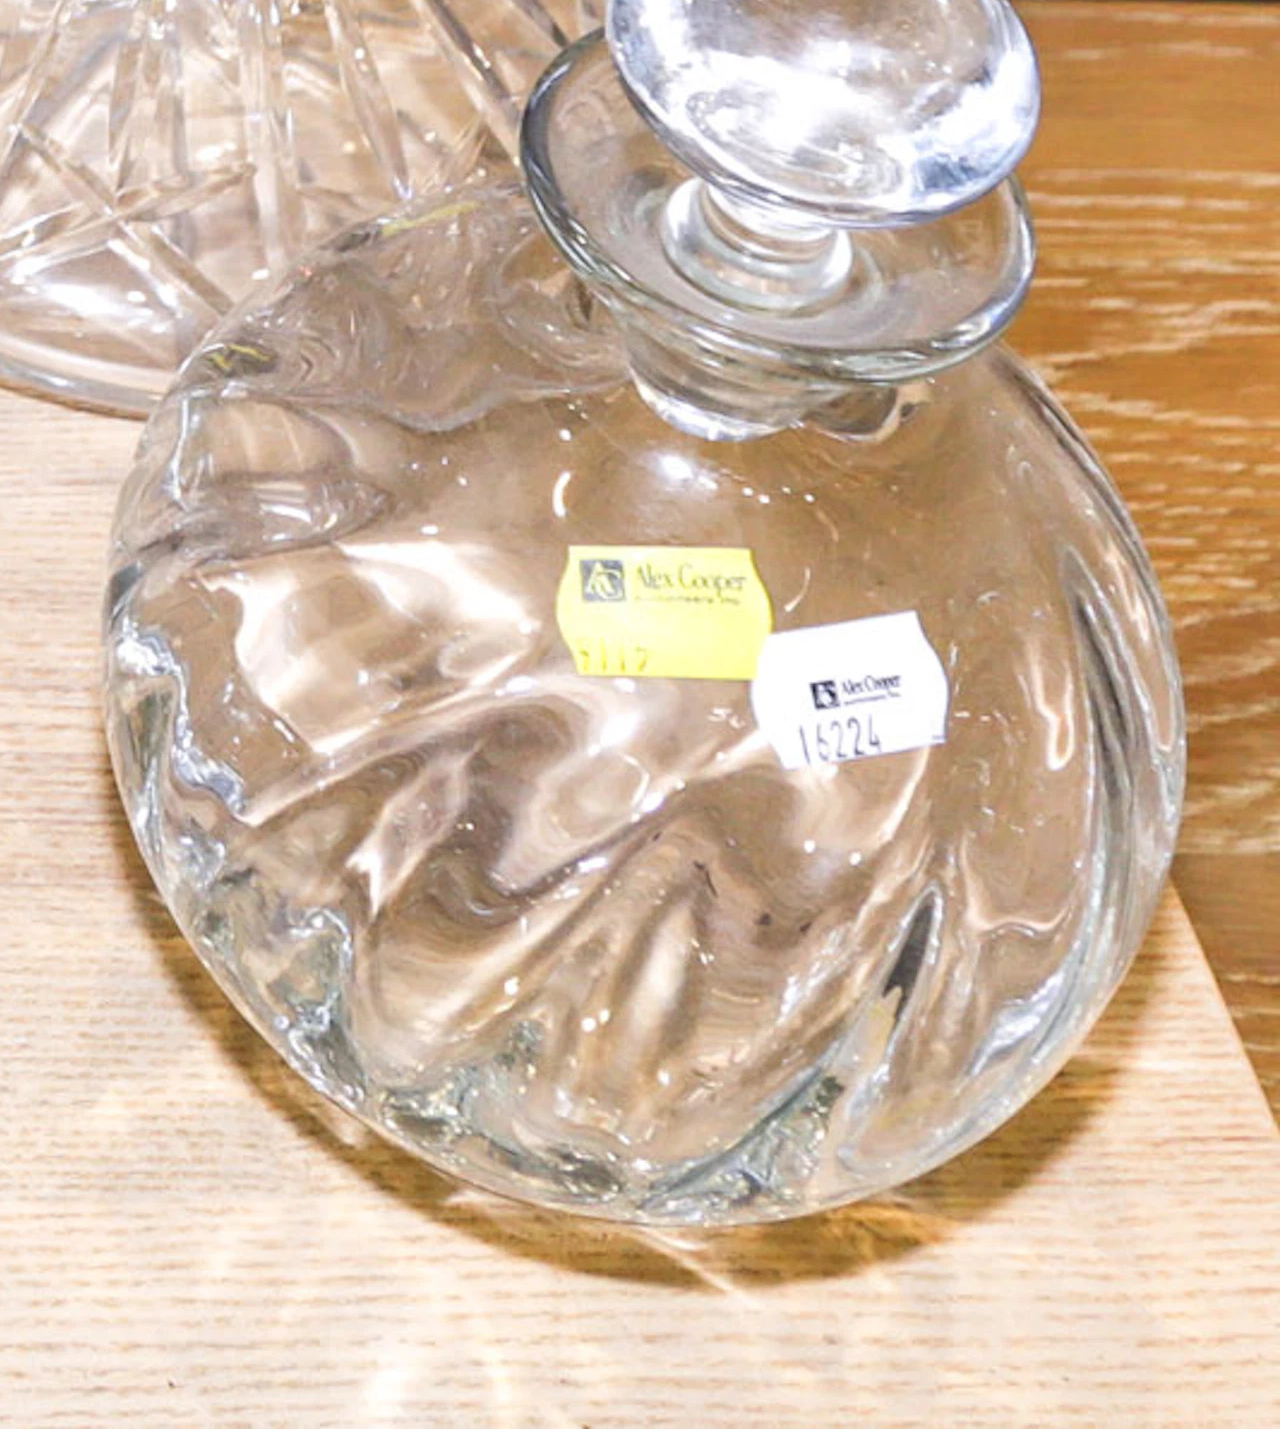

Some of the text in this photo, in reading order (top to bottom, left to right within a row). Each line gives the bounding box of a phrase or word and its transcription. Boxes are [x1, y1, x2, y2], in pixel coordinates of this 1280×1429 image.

[634, 563, 673, 590] Alex
[678, 562, 747, 599] Cooper
[798, 714, 881, 765] 16224
